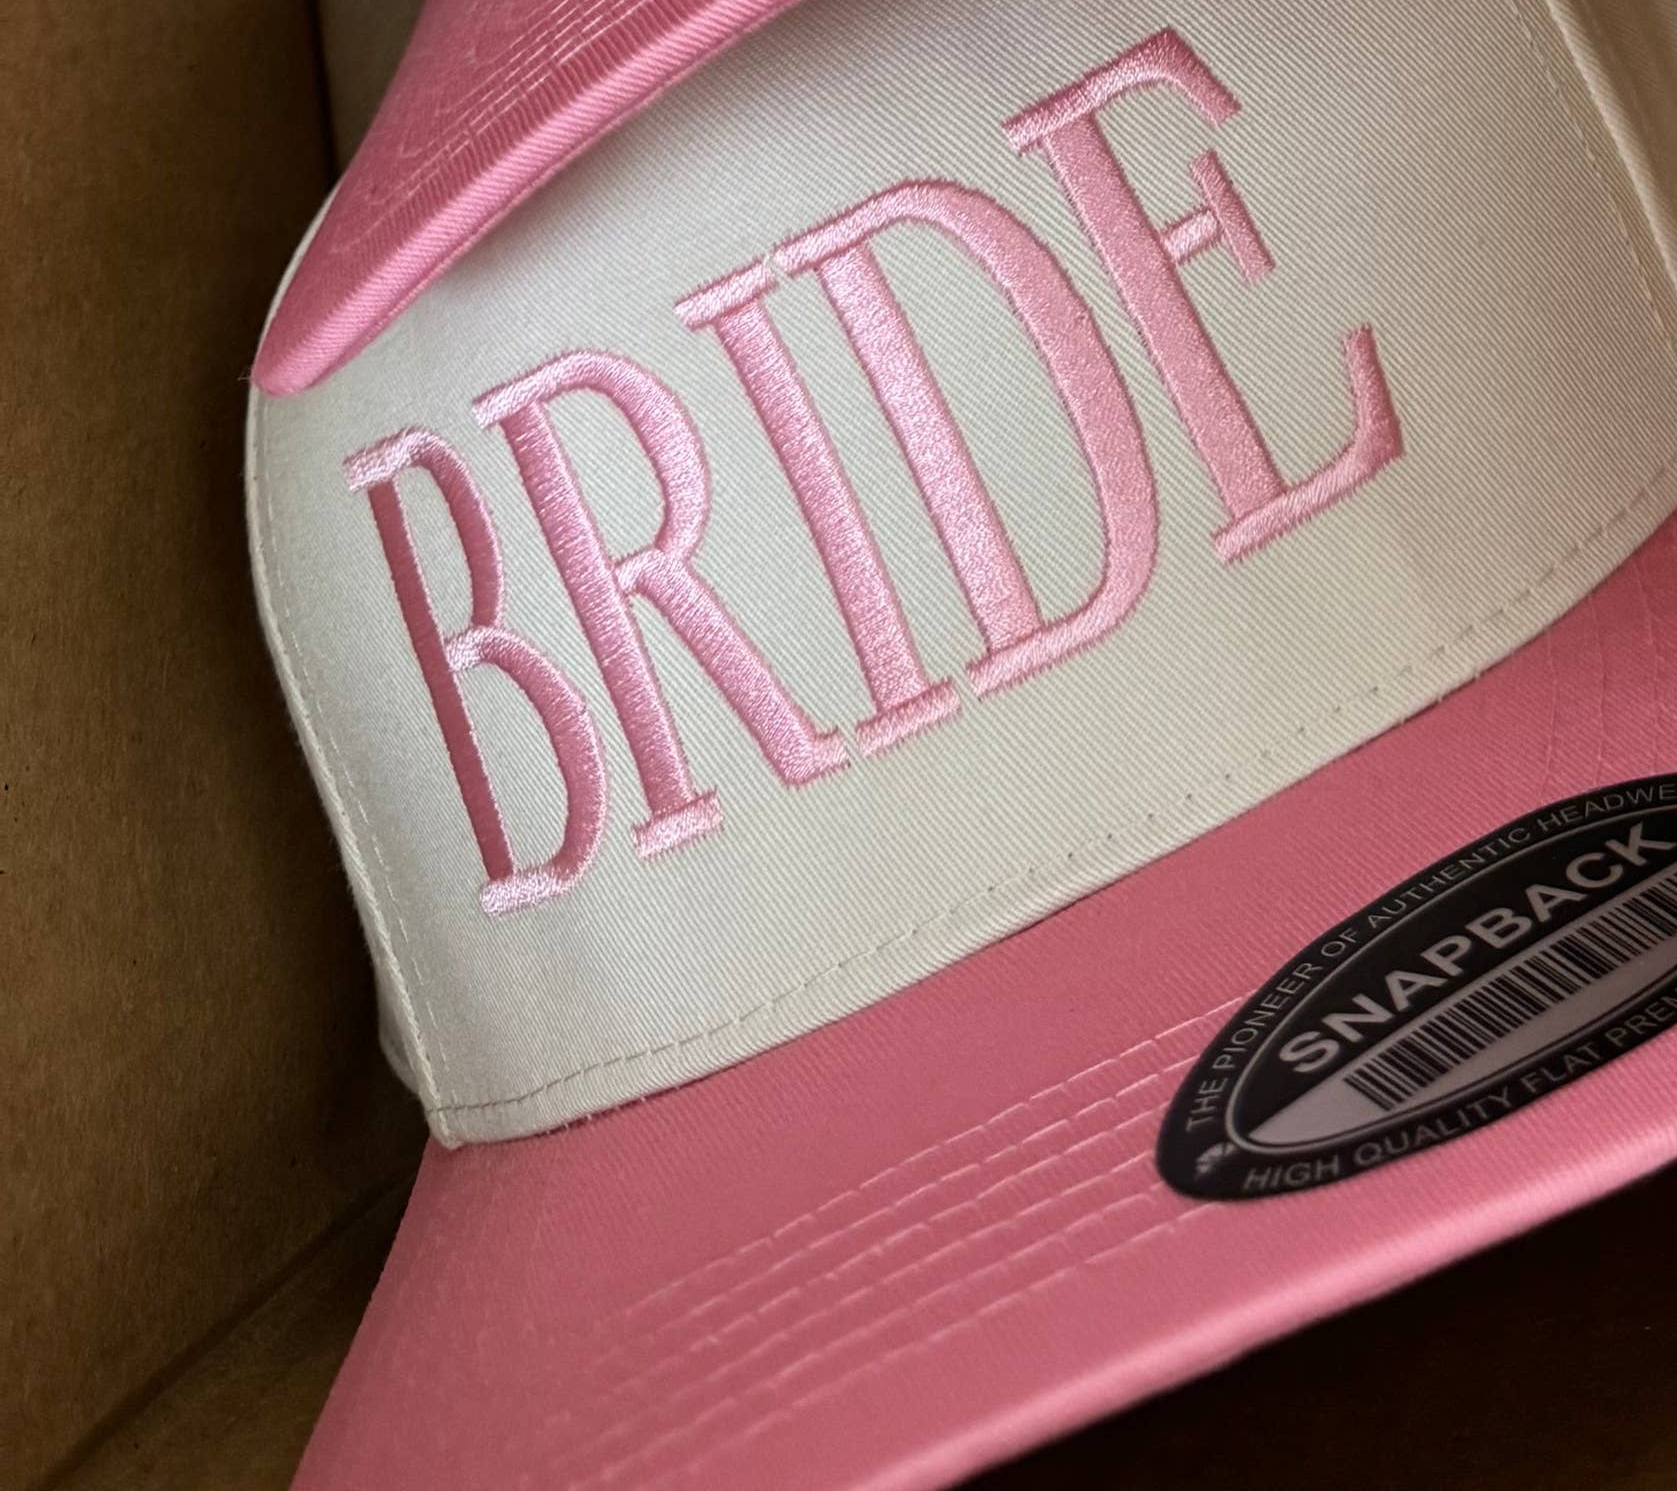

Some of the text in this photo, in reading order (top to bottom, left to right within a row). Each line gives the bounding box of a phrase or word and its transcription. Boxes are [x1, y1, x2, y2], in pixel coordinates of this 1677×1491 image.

[343, 26, 1405, 918] BRIDE
[1185, 1077, 1228, 1133] THE
[1211, 961, 1323, 1072] PIONEER
[1320, 927, 1360, 959] OF
[1367, 827, 1532, 929] AUTHENTIC
[1242, 1155, 1340, 1191] HIGH
[1353, 1086, 1512, 1167] QUALITY
[1520, 1043, 1602, 1094] FLAT
